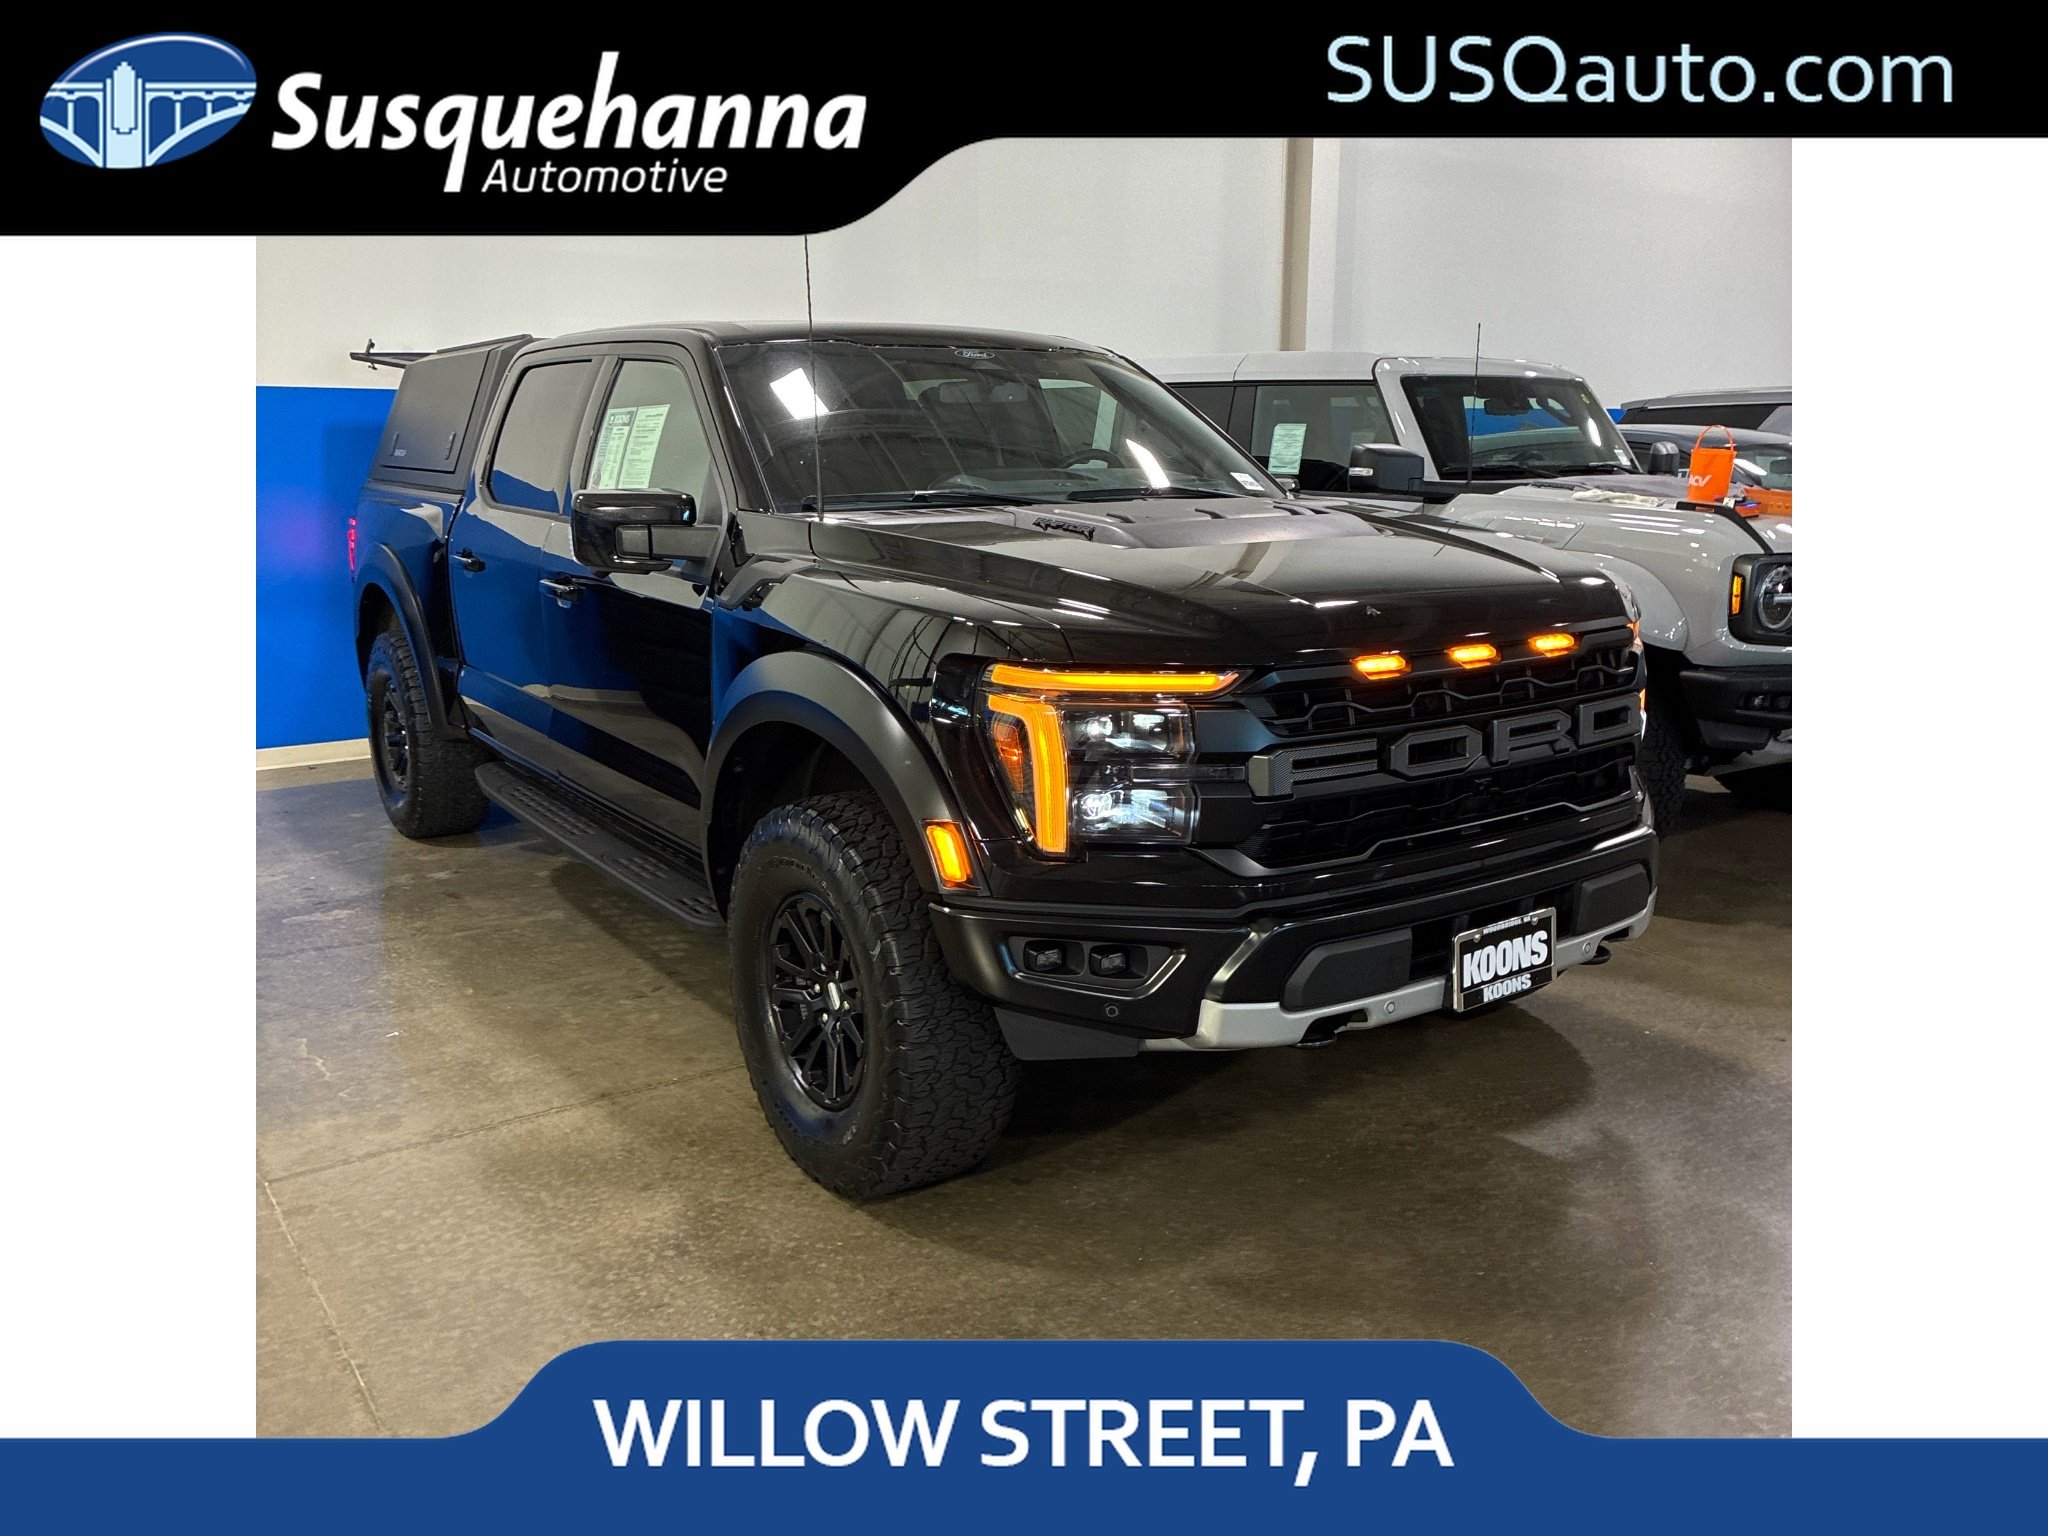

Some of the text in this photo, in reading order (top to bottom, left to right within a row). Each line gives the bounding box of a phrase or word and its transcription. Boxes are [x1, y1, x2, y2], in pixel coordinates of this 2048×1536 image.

[1032, 517, 1097, 541] RAPTOR
[1247, 692, 1641, 797] FORD
[1463, 930, 1548, 988] KOONS
[1483, 974, 1532, 1003] KOONS
